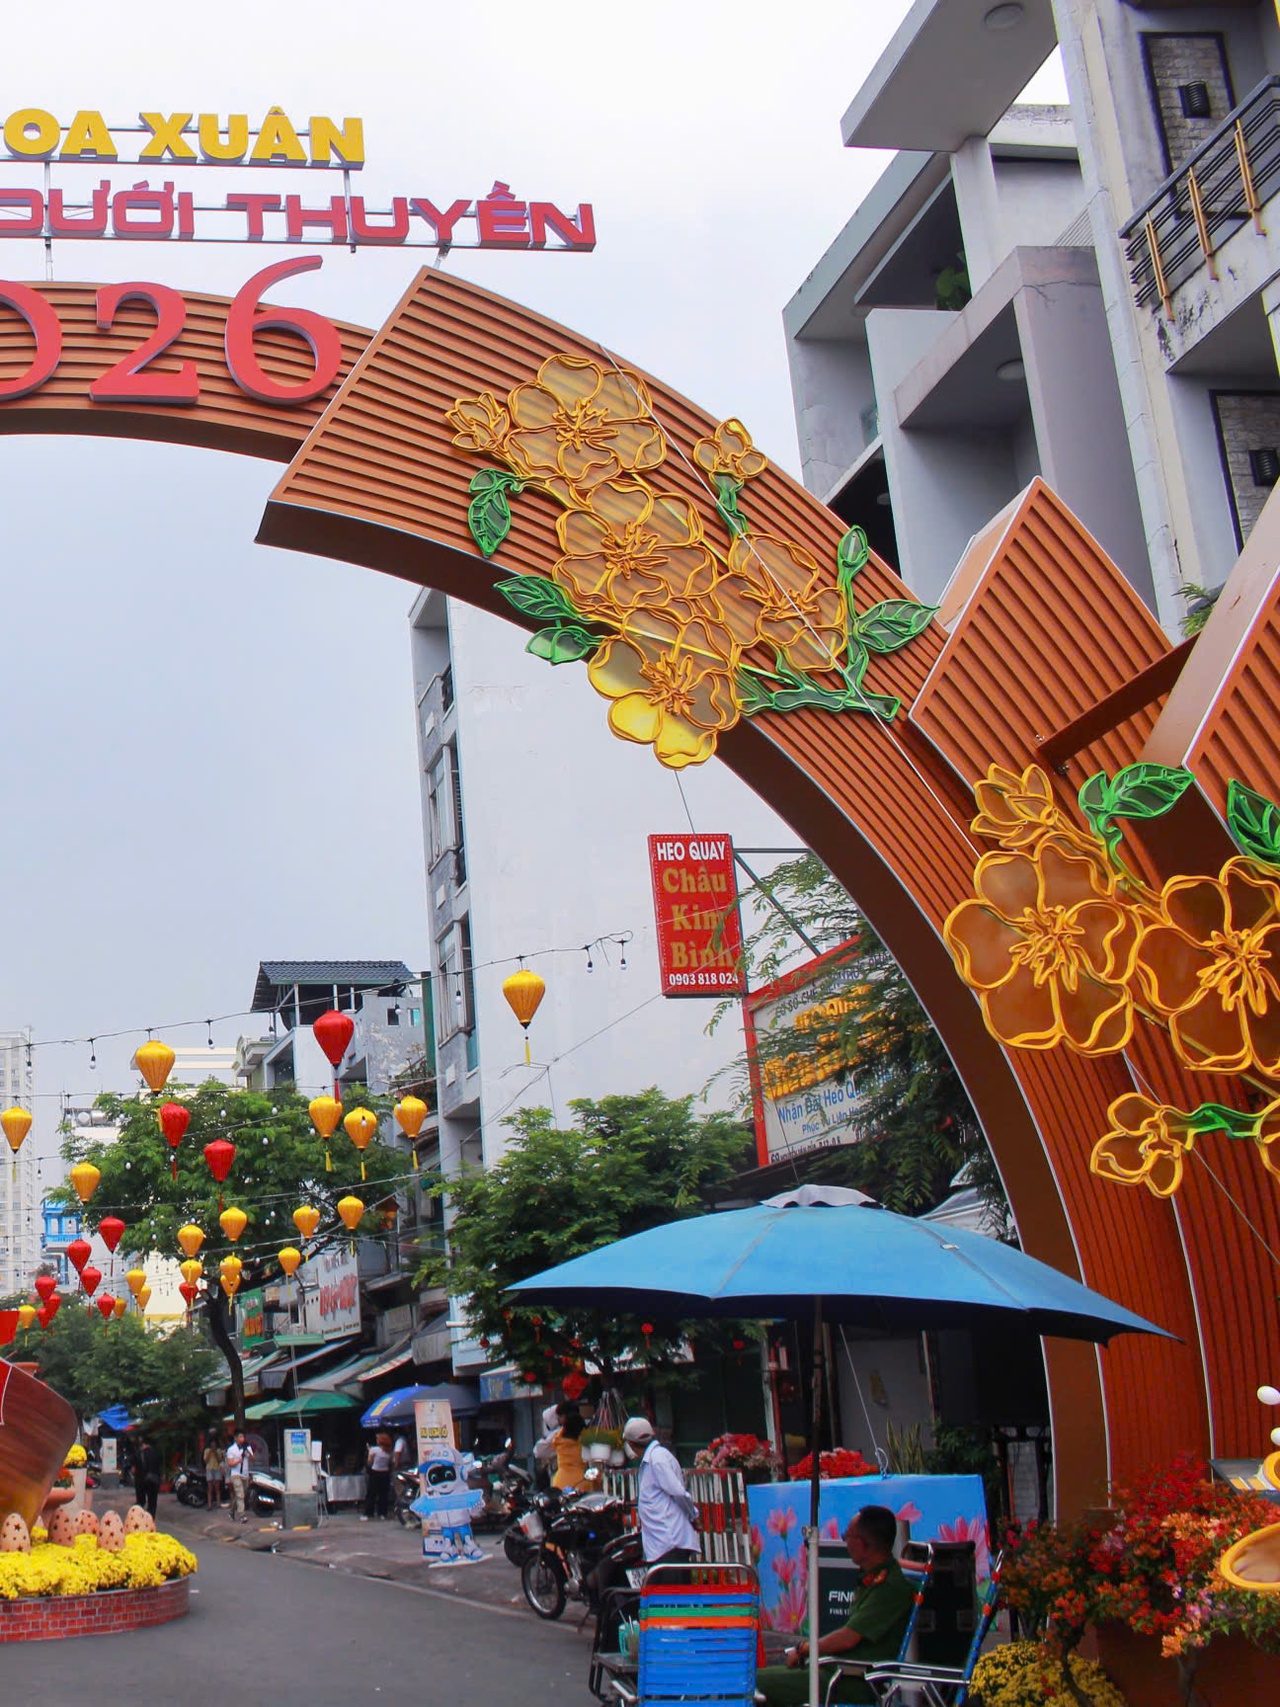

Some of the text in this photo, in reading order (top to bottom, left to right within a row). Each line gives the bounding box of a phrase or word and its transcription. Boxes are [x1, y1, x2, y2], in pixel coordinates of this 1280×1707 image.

[138, 105, 365, 170] XUÂN
[226, 180, 597, 252] THUYỀN
[656, 840, 726, 861] HEO QUAY
[662, 866, 728, 894] Châu
[671, 904, 727, 931] Kim
[670, 941, 735, 968] Bình
[669, 971, 739, 986] 0903 818 024
[778, 1102, 803, 1125] Nhận
[823, 1088, 845, 1108] Heo
